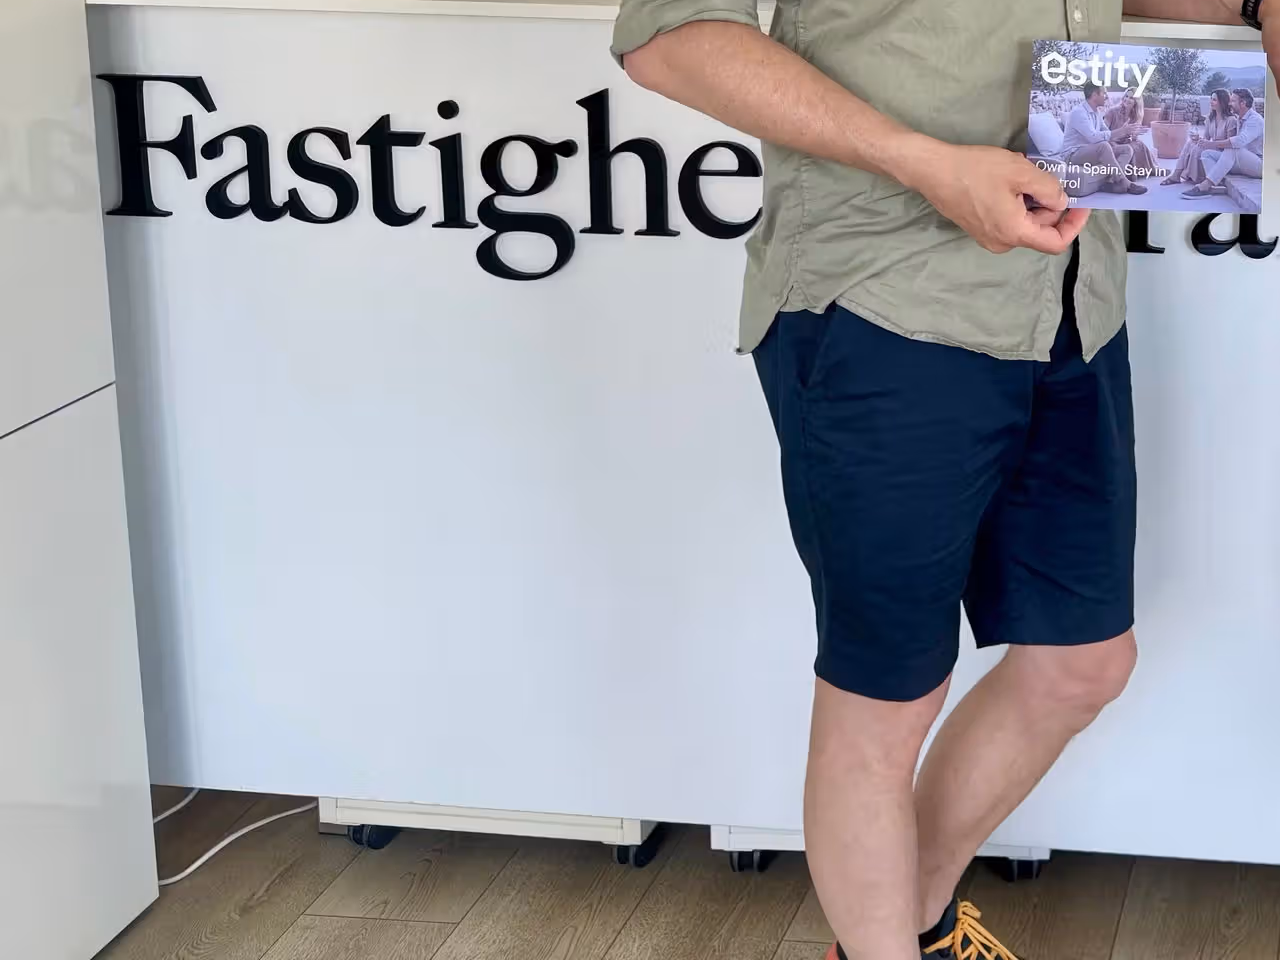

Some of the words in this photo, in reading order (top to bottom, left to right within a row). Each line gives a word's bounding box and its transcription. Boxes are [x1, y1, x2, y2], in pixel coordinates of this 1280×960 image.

[1041, 50, 1156, 98] estity
[1036, 160, 1066, 172] Own
[1068, 161, 1080, 173] in
[1082, 162, 1121, 176] Spain.
[1124, 163, 1152, 179] Stay
[1155, 166, 1166, 176] in
